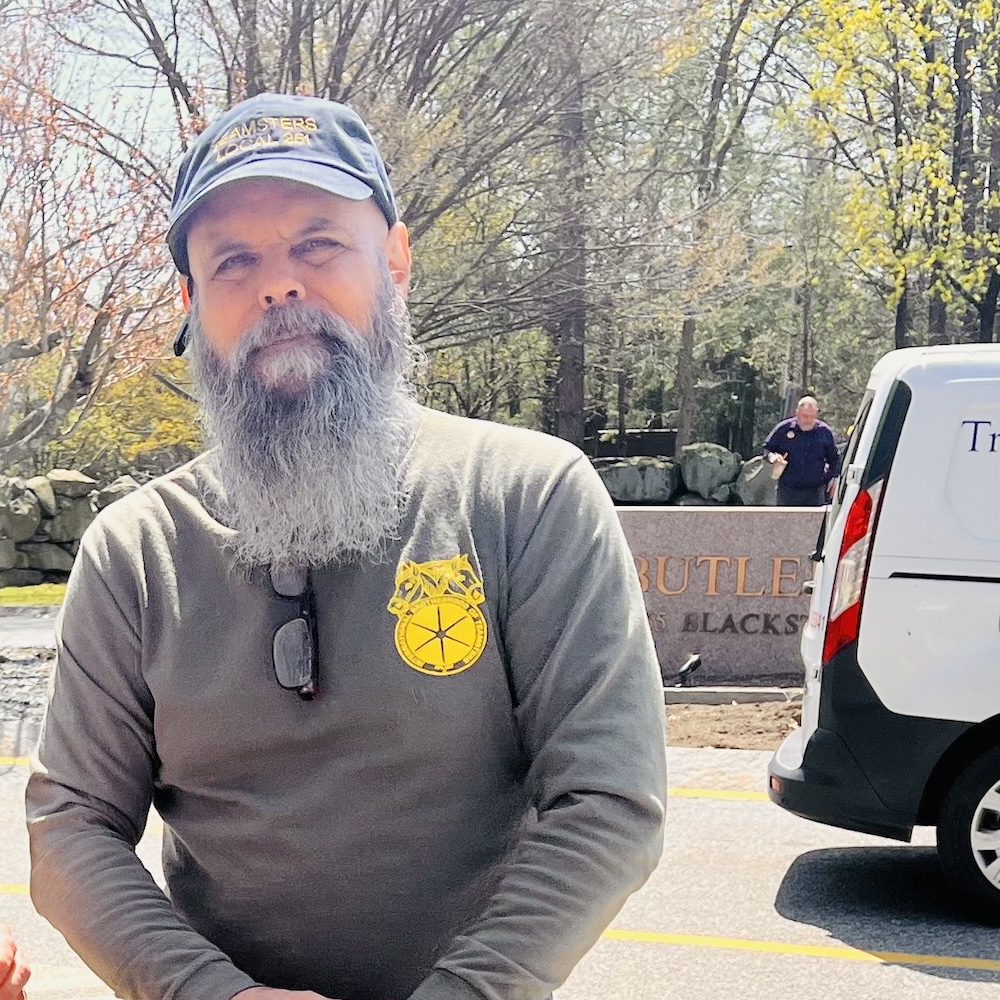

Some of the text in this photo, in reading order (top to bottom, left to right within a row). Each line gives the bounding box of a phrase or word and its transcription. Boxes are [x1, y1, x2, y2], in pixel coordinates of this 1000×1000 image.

[213, 117, 318, 152] TEAMSTERS
[216, 134, 279, 162] LOCAL
[635, 555, 817, 597] BUTLE
